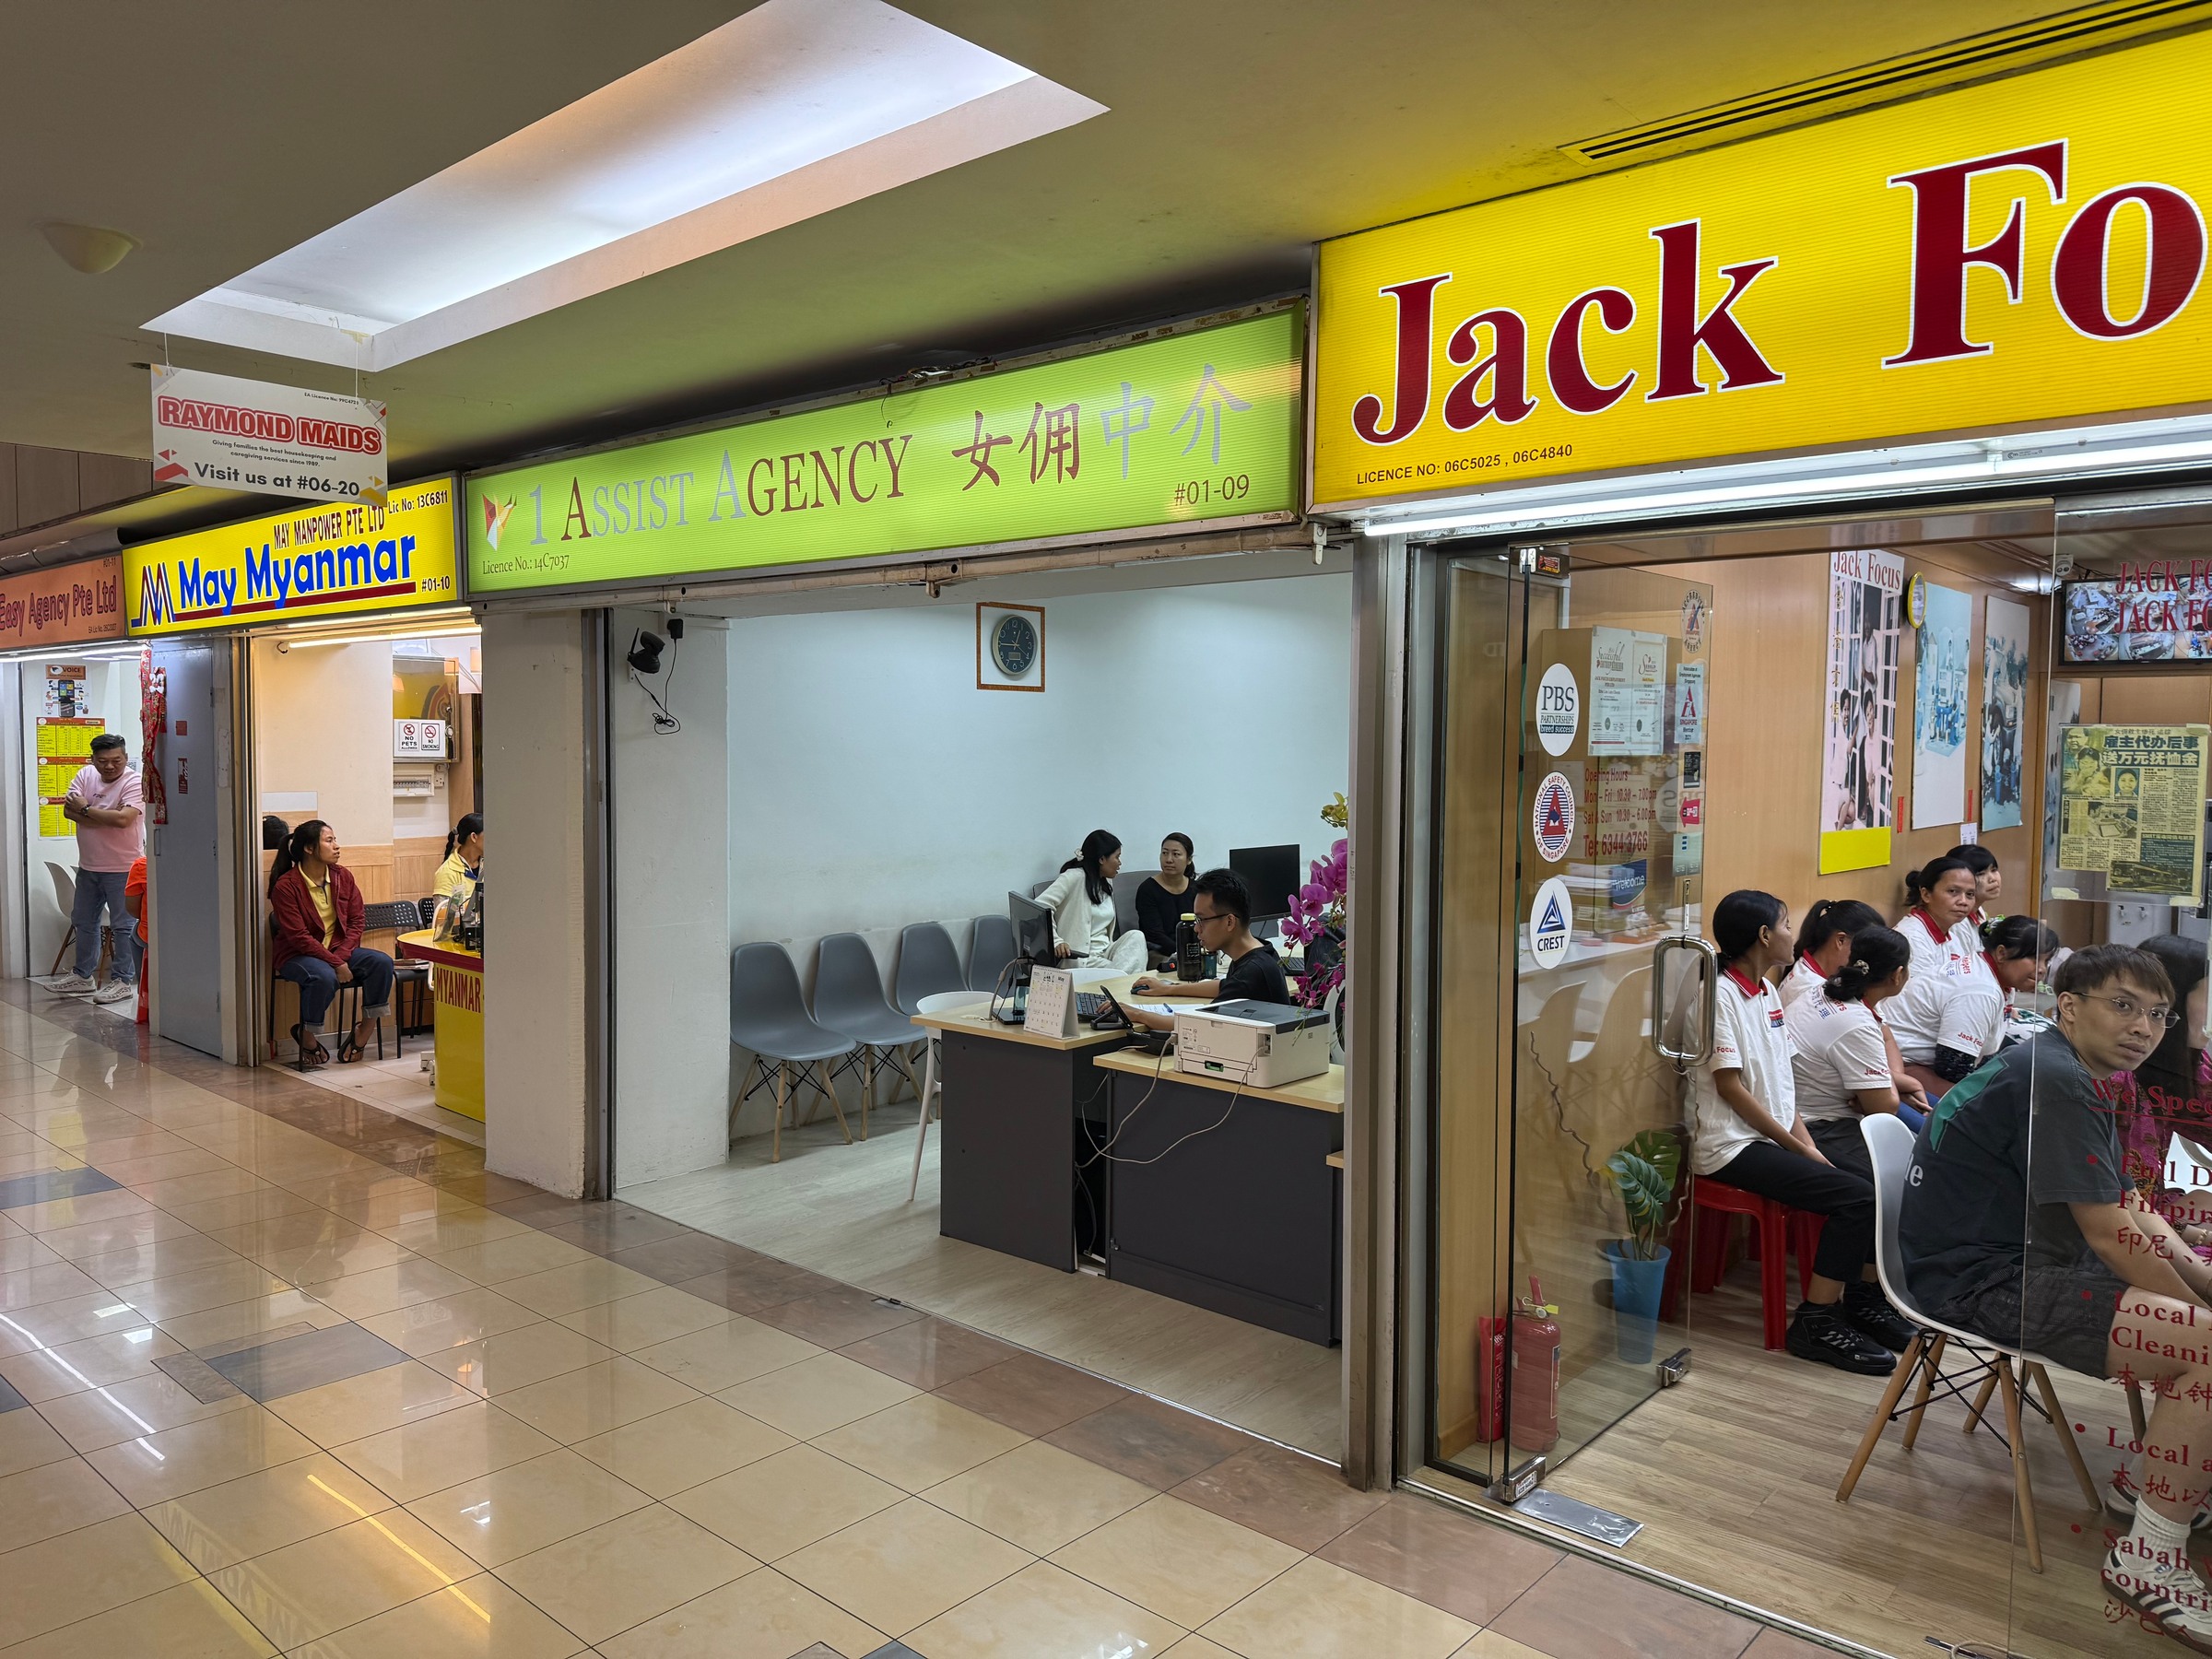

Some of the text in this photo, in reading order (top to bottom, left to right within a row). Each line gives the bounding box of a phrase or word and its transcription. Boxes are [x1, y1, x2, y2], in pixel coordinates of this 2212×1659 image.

[1351, 218, 1786, 446] Jack
[158, 395, 382, 455] RAYMOND MAIDS
[951, 363, 1253, 491] 女佣中介
[212, 439, 233, 449] Giving
[233, 441, 258, 451] families
[284, 448, 324, 460] housekeeping
[229, 451, 264, 461] caregiving
[264, 454, 288, 463] services
[1357, 466, 1413, 485] LICENCE
[1417, 464, 1441, 477] NO:
[1444, 453, 1501, 473] 06C5025
[1512, 443, 1573, 464] 06C4840
[194, 462, 359, 497] Visit us at #06-20
[1174, 473, 1251, 507] #01-09
[387, 489, 448, 514] Lic No: 13C6811
[529, 484, 548, 546] 1
[274, 505, 385, 549] MAY MANPOWER PTE LTD
[178, 557, 237, 616] May
[245, 535, 417, 609] Myanmar
[482, 560, 513, 575] Licence
[535, 552, 570, 572] 14C7037
[1833, 550, 1901, 592] Jack Focus
[2115, 559, 2182, 594] JACK
[420, 575, 451, 593] #01-10
[29, 593, 70, 630] Agency
[73, 584, 93, 618] Pte
[97, 575, 117, 614] Ltd
[2113, 600, 2180, 634] JACK
[1541, 685, 1575, 712] PBS
[1540, 714, 1574, 724] PARTNERSHIPS
[1541, 724, 1574, 734] breed success
[2102, 750, 2198, 767] 送万元抚恤金
[2103, 735, 2200, 749] 雇主代办后事
[1585, 767, 1629, 785] Opening Hours
[1535, 775, 1574, 828] NATIONAL SAFETY COUNCIL
[1583, 789, 1597, 804] Mon
[1604, 788, 1613, 803] Fri
[1583, 810, 1594, 825] Sat
[1600, 809, 1613, 824] Sun
[1536, 837, 1570, 860] OF SINGAPORE
[1602, 832, 1624, 856] 6344
[1615, 875, 1645, 891] Welcome
[1537, 935, 1565, 952] CREST
[436, 966, 482, 1014] MYANMAR
[1957, 1031, 1974, 1042] Jack
[2092, 1078, 2135, 1105] We
[2122, 1155, 2177, 1182] Full
[2114, 1291, 2196, 1327] Local
[2112, 1326, 2209, 1366] Cleani
[2106, 1426, 2190, 1467] Local
[2107, 1462, 2211, 1512] 本地以
[2103, 1527, 2191, 1571] Sabah
[2100, 1568, 2209, 1613] countri
